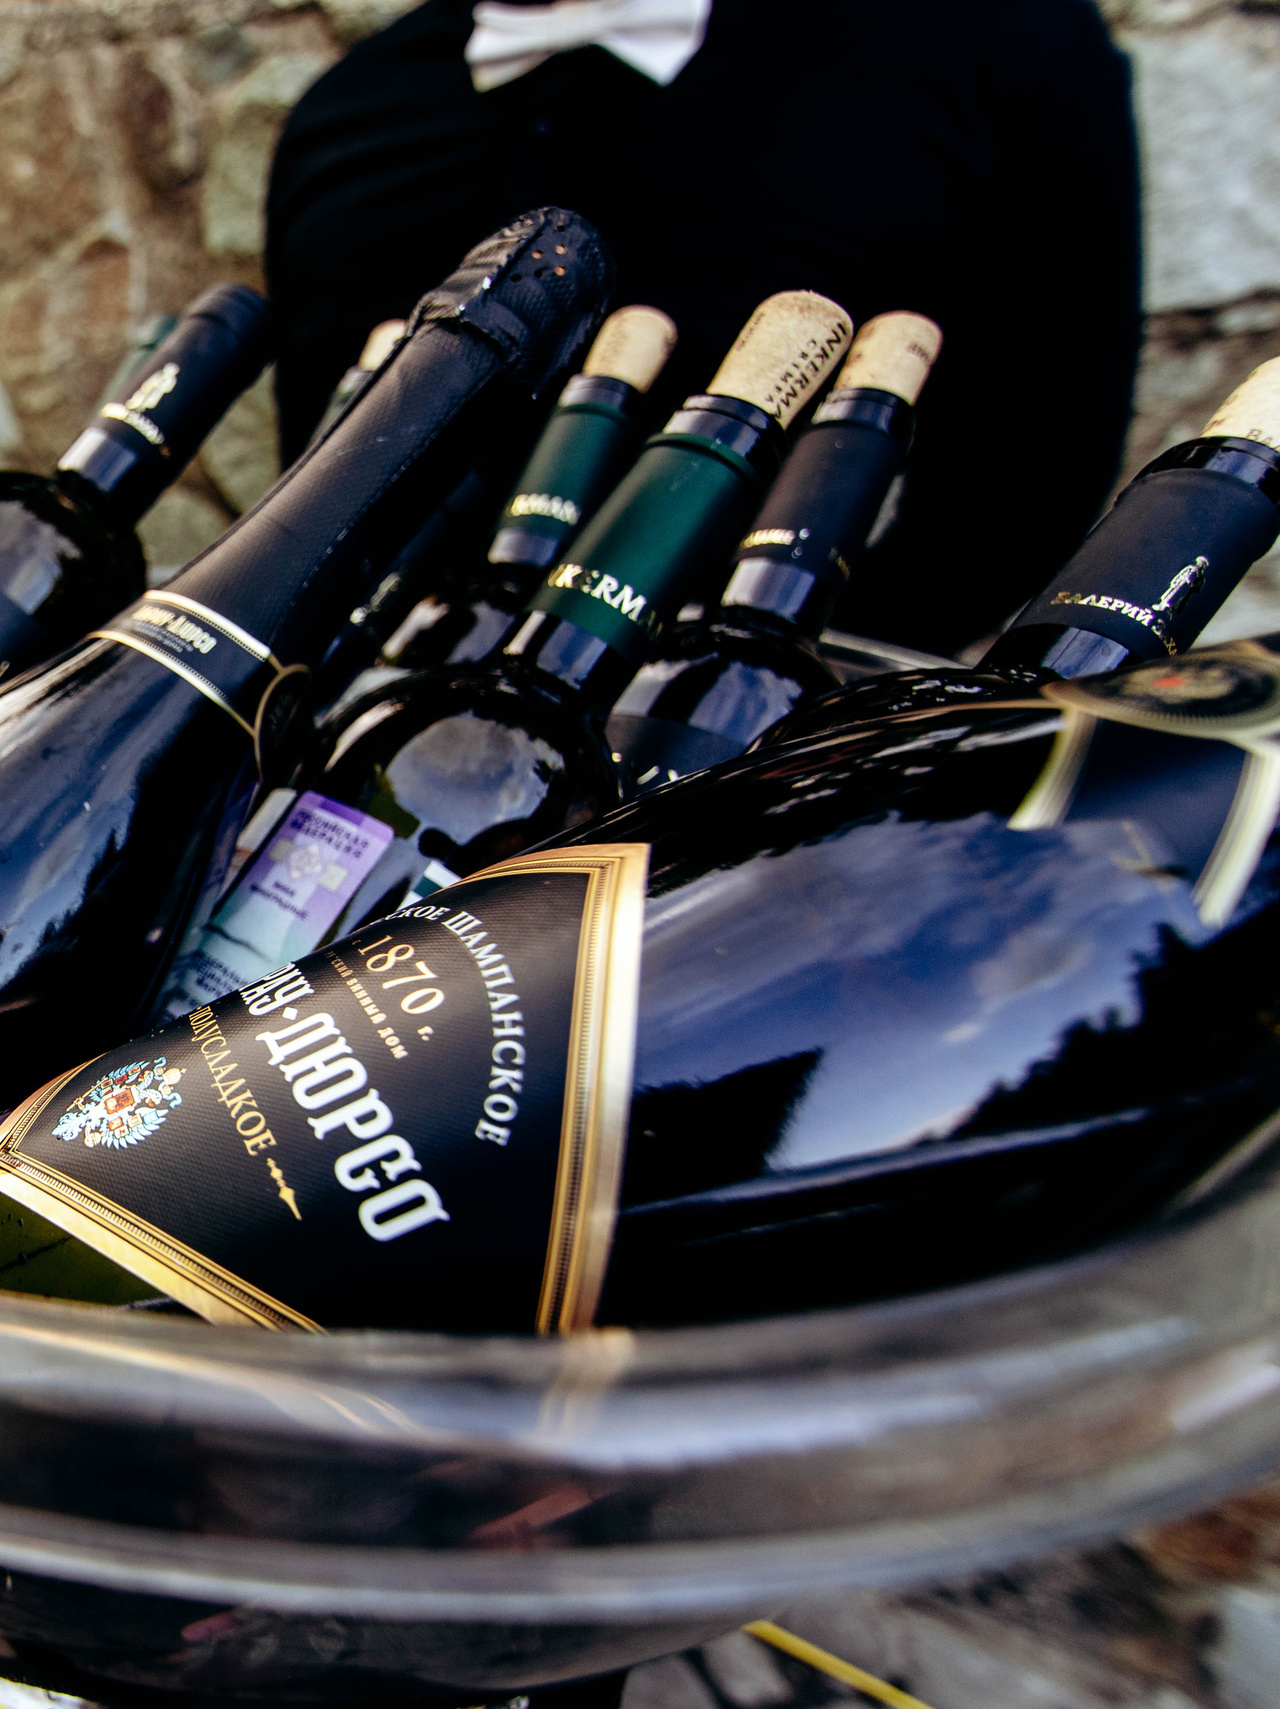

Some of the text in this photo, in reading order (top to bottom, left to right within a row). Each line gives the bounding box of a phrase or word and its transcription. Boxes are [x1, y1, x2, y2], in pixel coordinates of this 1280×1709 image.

[773, 321, 847, 419] INKERMA
[345, 977, 388, 1025] ВИННЫЙ
[376, 1026, 409, 1060] ДОМ
[357, 934, 446, 1015] 1870
[441, 911, 527, 1147] ШАМПАНСКОЕ
[188, 1005, 278, 1157] ПОЛУСЛАДКОЕ
